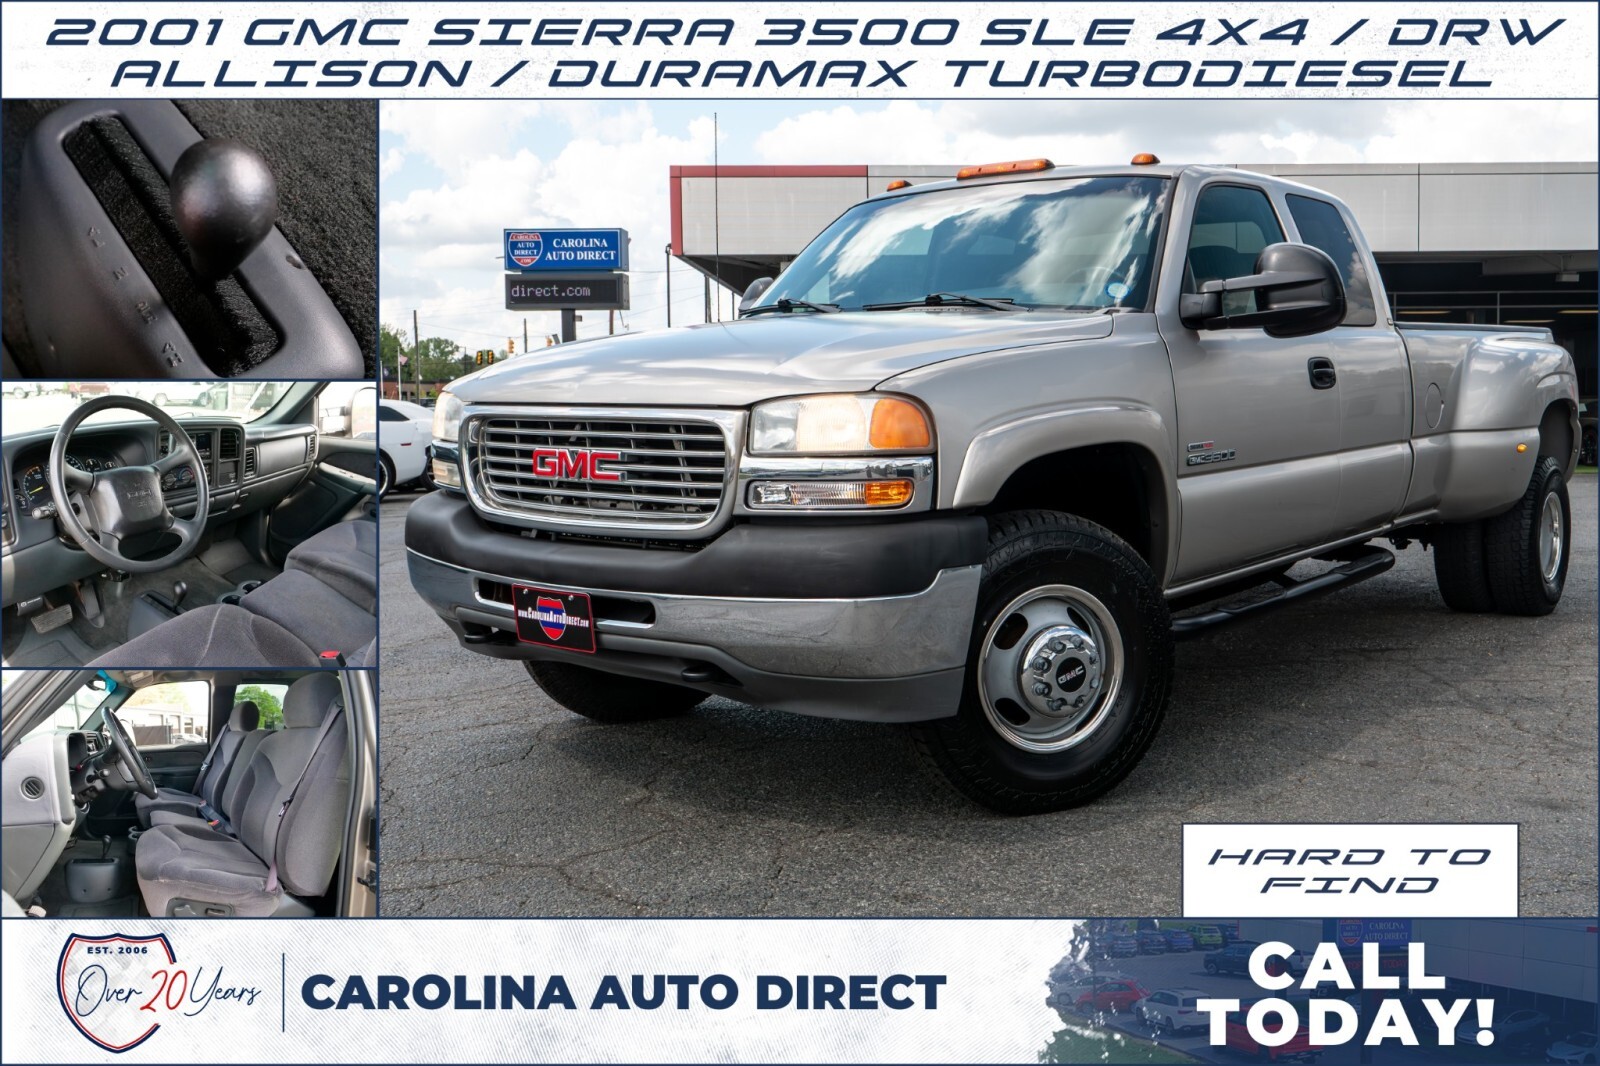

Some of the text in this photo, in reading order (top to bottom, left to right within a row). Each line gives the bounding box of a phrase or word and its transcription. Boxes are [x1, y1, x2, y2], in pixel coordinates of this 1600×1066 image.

[552, 238, 608, 248] CAROLINA
[545, 250, 616, 261] AUTO DIRECT
[511, 285, 591, 297] direct.com
[532, 448, 622, 481] GMC
[1057, 665, 1084, 685] GMC
[1369, 922, 1405, 930] CAROLINA
[1364, 932, 1409, 941] AUTO DIRECT
